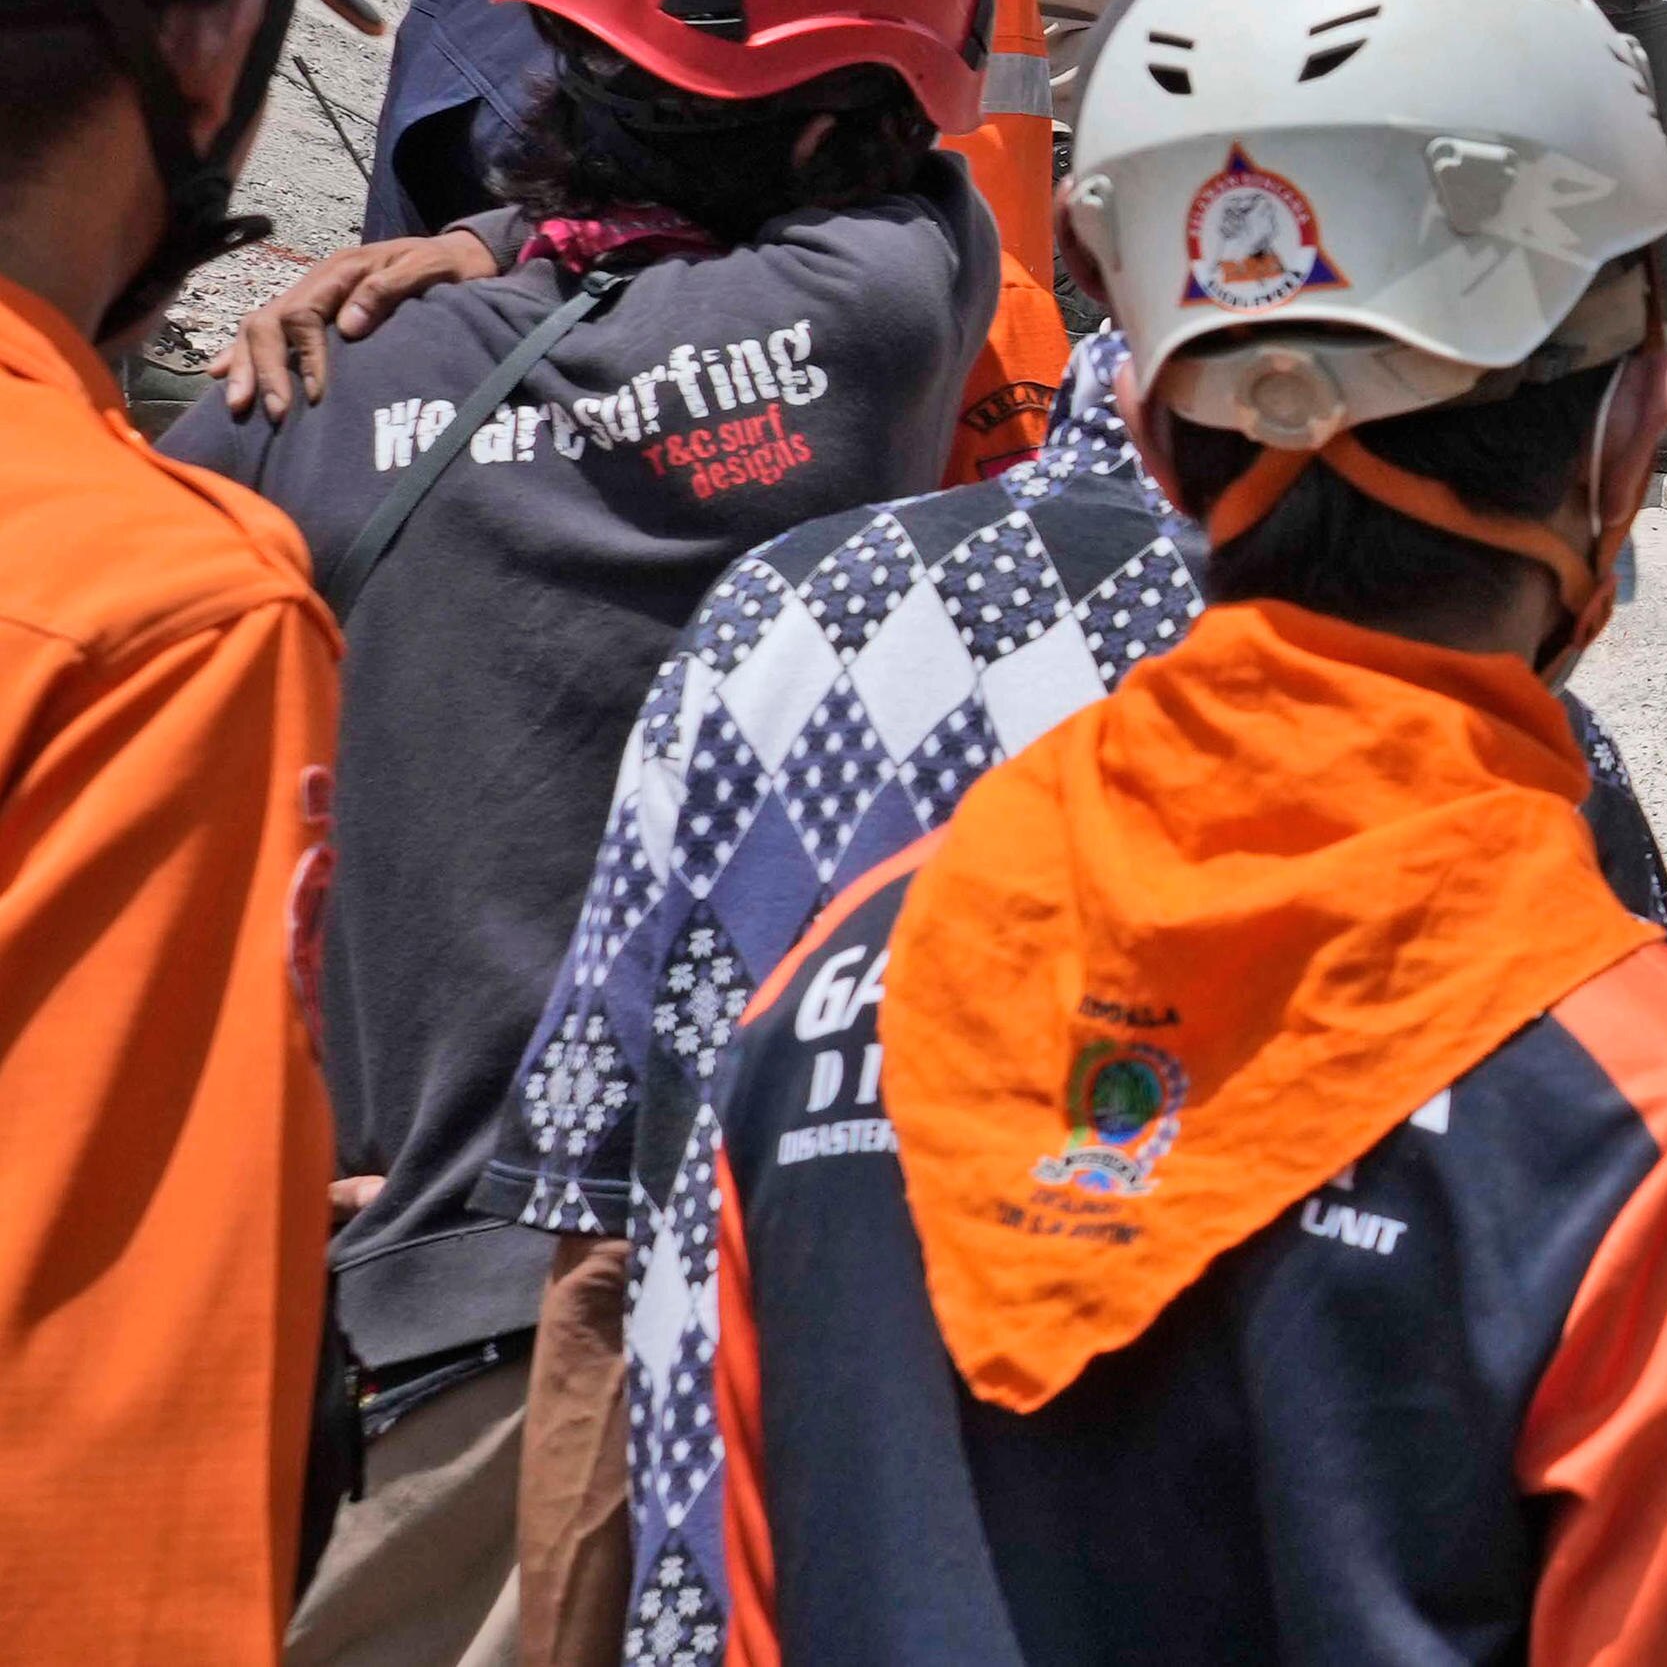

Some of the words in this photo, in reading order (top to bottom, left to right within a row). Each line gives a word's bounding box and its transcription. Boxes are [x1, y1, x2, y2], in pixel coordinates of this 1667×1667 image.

[718, 402, 786, 451] surf
[691, 432, 814, 500] designs
[1301, 1198, 1410, 1256] UNIT
